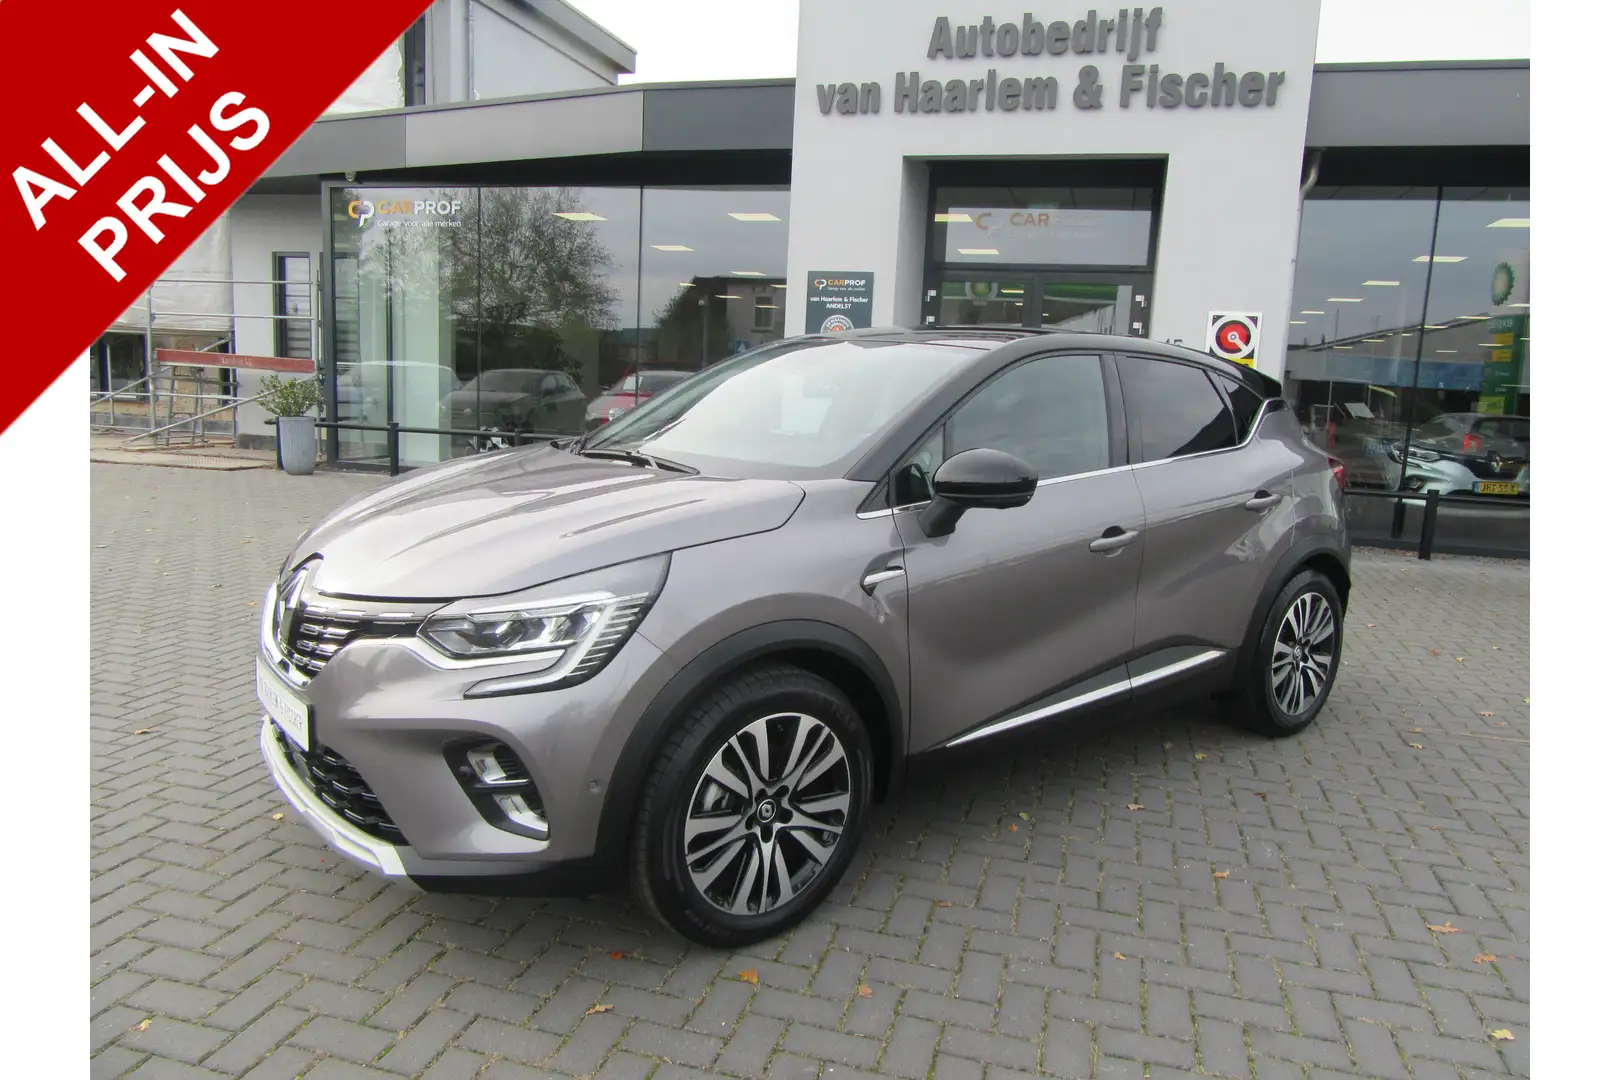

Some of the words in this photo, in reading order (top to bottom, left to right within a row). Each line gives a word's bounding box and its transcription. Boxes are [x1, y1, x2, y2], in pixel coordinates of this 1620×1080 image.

[927, 7, 1163, 61] Autobedrijf
[816, 80, 881, 115] van
[894, 69, 1058, 114] Haarlem
[1073, 65, 1103, 111] &
[1119, 62, 1286, 109] Fischer
[377, 200, 461, 215] CARPROF
[435, 219, 462, 228] merken
